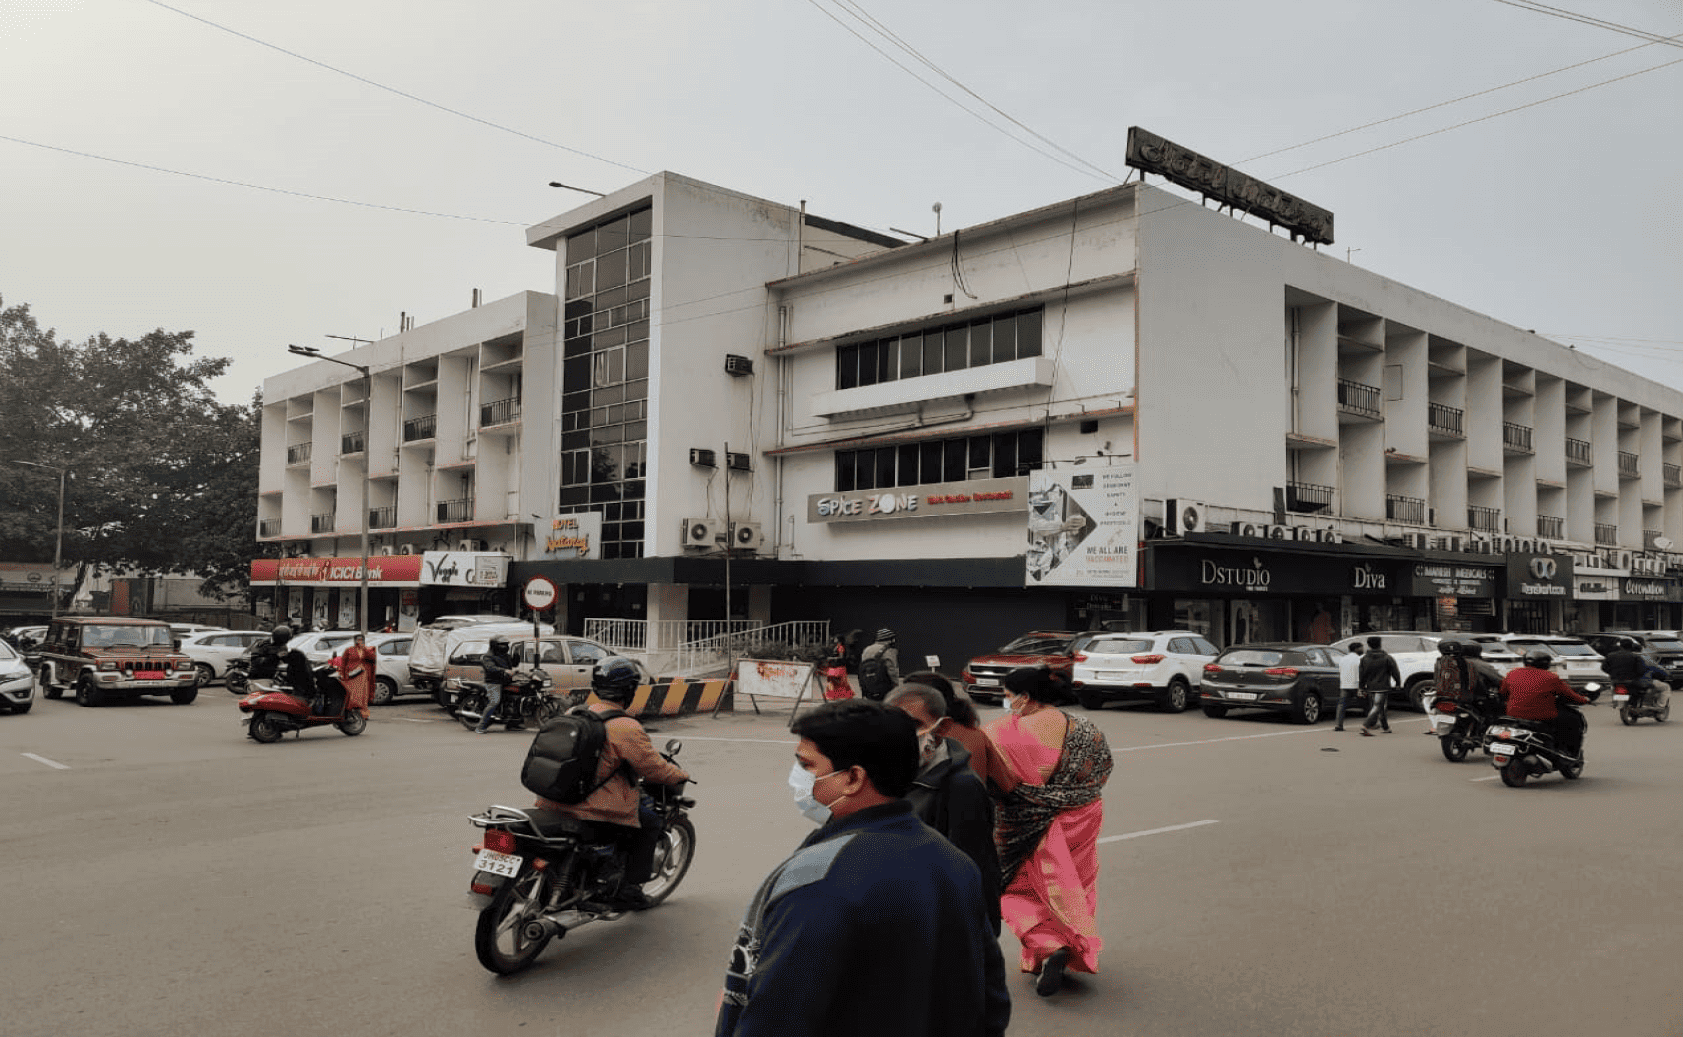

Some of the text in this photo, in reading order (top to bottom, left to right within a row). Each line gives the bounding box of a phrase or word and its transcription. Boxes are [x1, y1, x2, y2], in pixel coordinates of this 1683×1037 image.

[1099, 546, 1112, 555] ALL
[1114, 546, 1128, 554] ARE
[354, 565, 382, 579] Bnk
[1354, 564, 1386, 589] Diva
[478, 859, 514, 875] 3121
